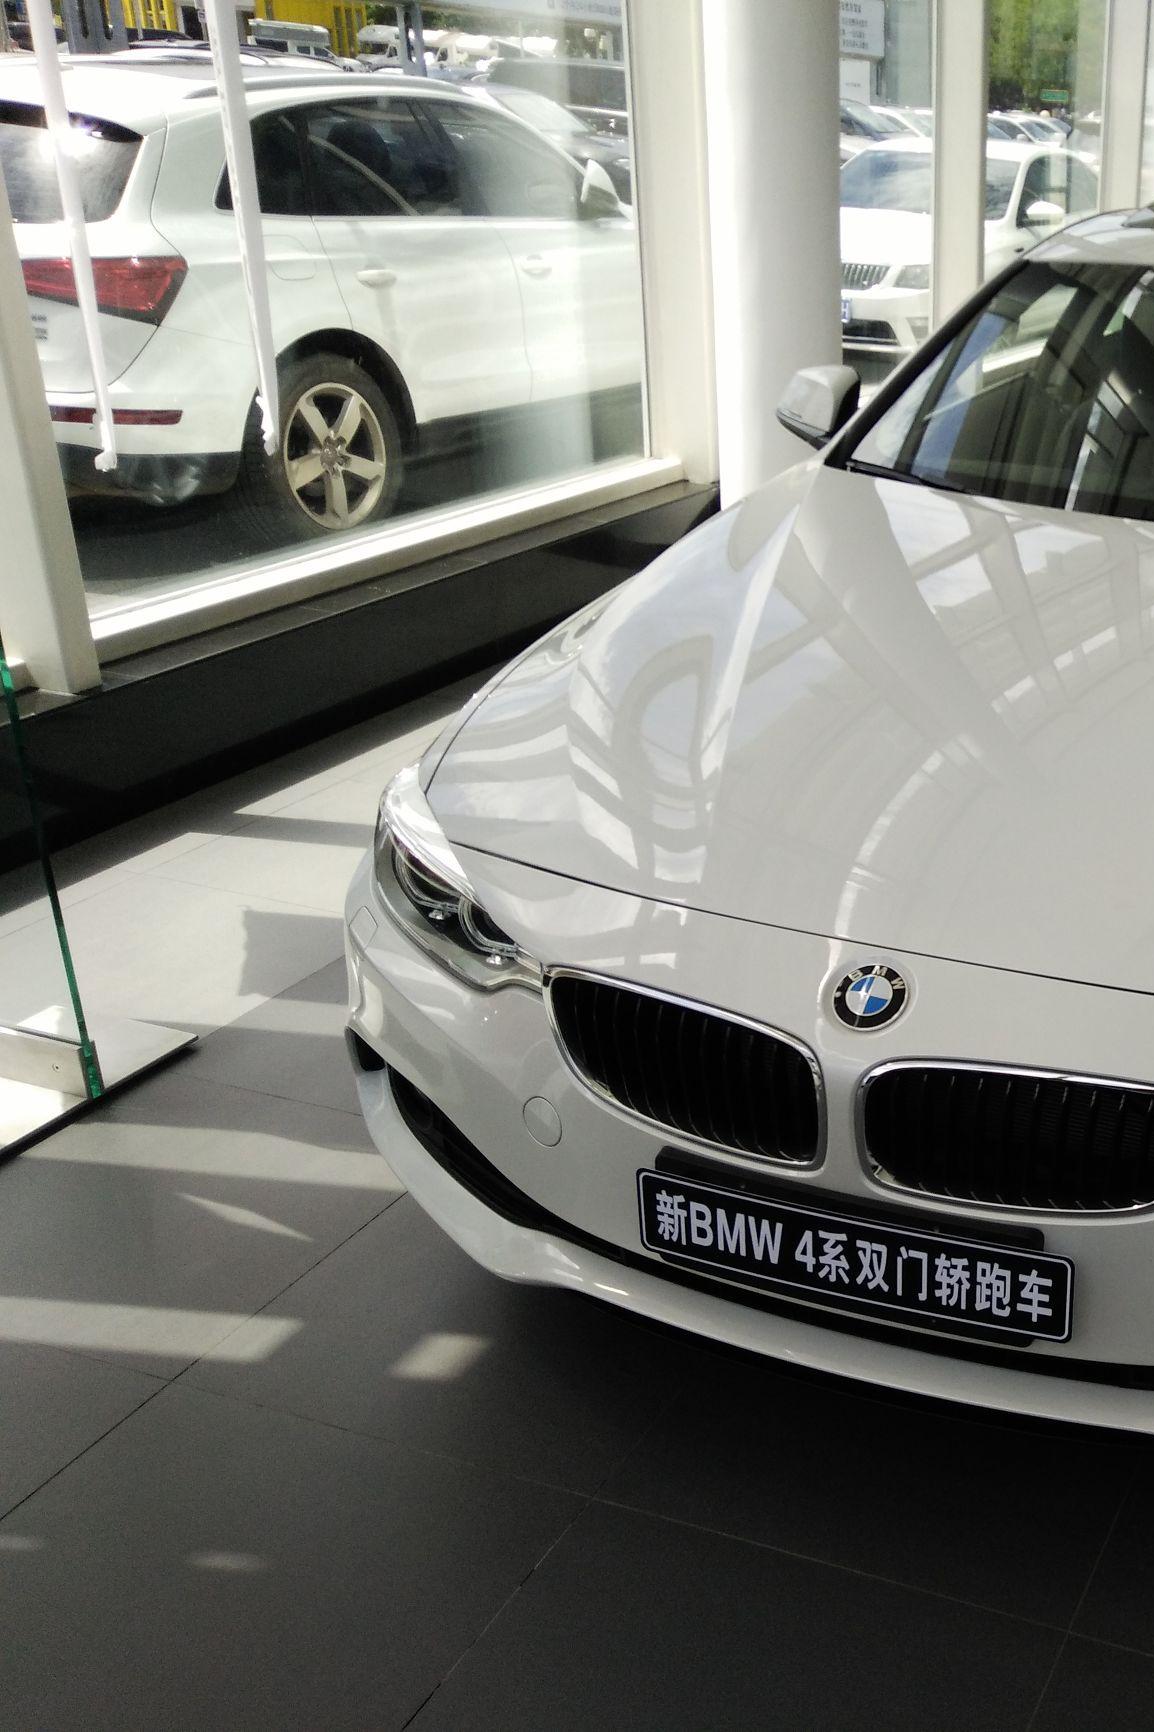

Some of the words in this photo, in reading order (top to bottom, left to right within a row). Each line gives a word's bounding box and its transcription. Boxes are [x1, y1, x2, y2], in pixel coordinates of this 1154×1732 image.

[848, 965, 905, 990] BMW
[656, 1190, 783, 1264] 新BMW
[794, 1230, 1053, 1322] 4系双门轿跑车
